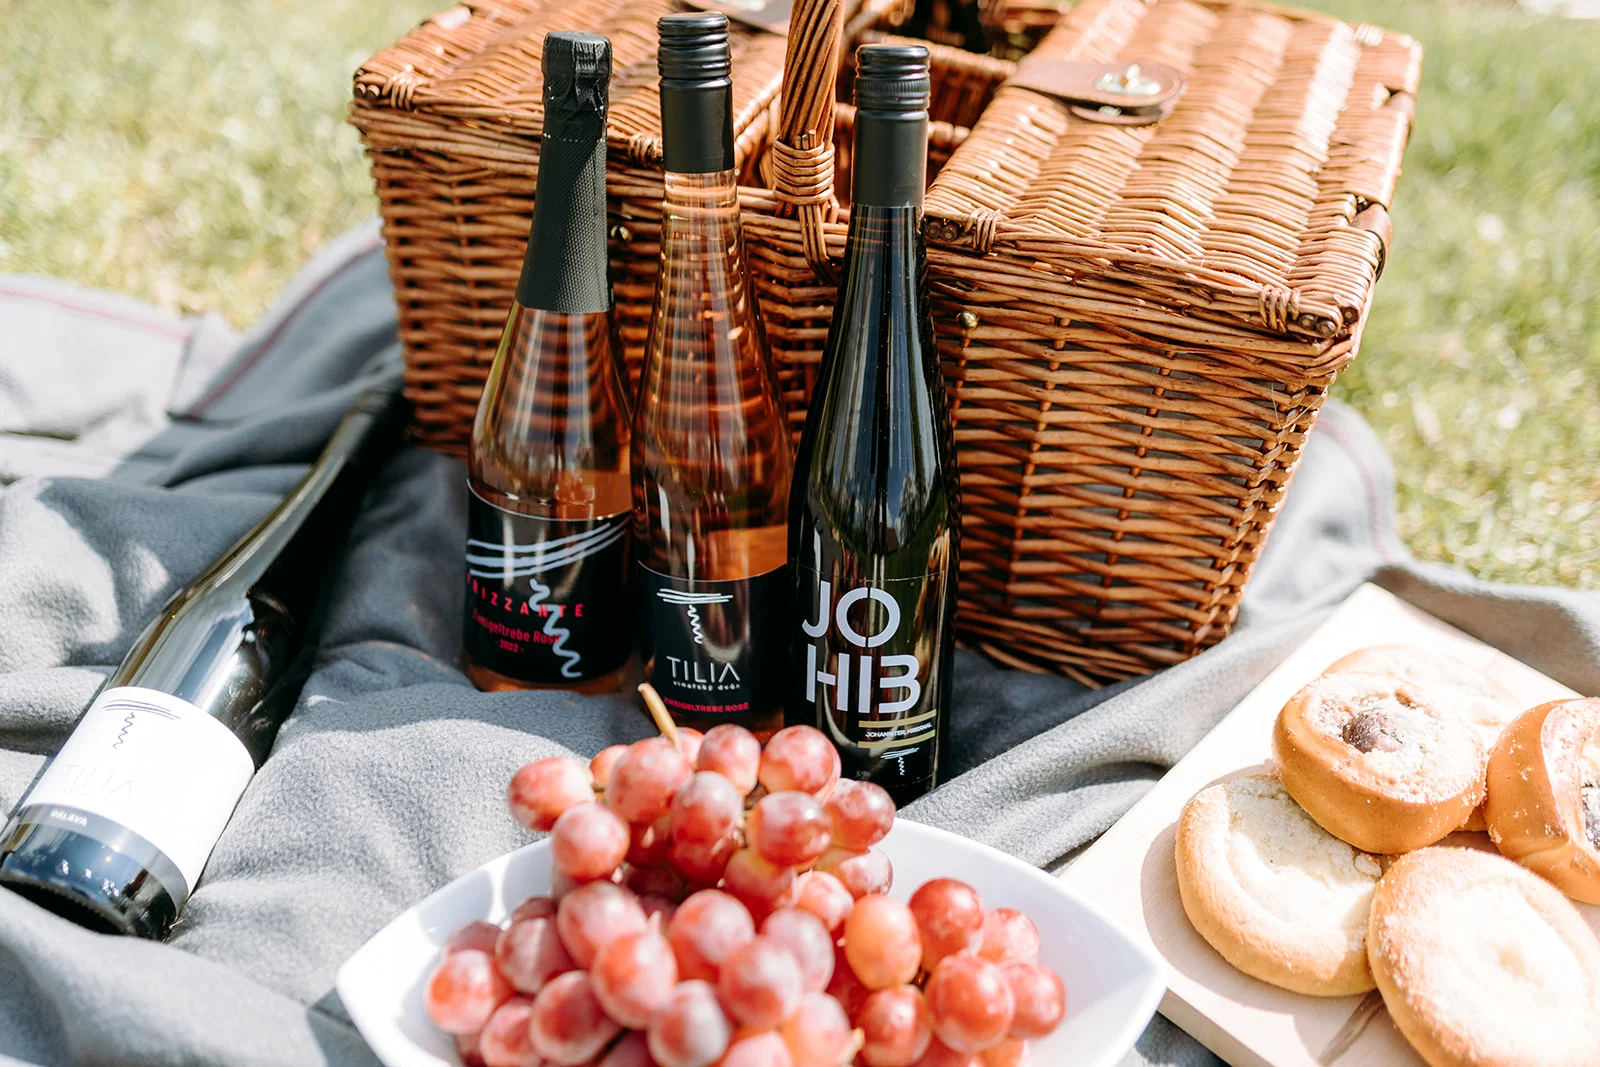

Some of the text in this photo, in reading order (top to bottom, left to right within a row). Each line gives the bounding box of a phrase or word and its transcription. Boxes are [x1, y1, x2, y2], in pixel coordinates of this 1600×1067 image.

[802, 580, 901, 648] JO
[666, 655, 741, 684] TILIA
[806, 643, 921, 714] HIB
